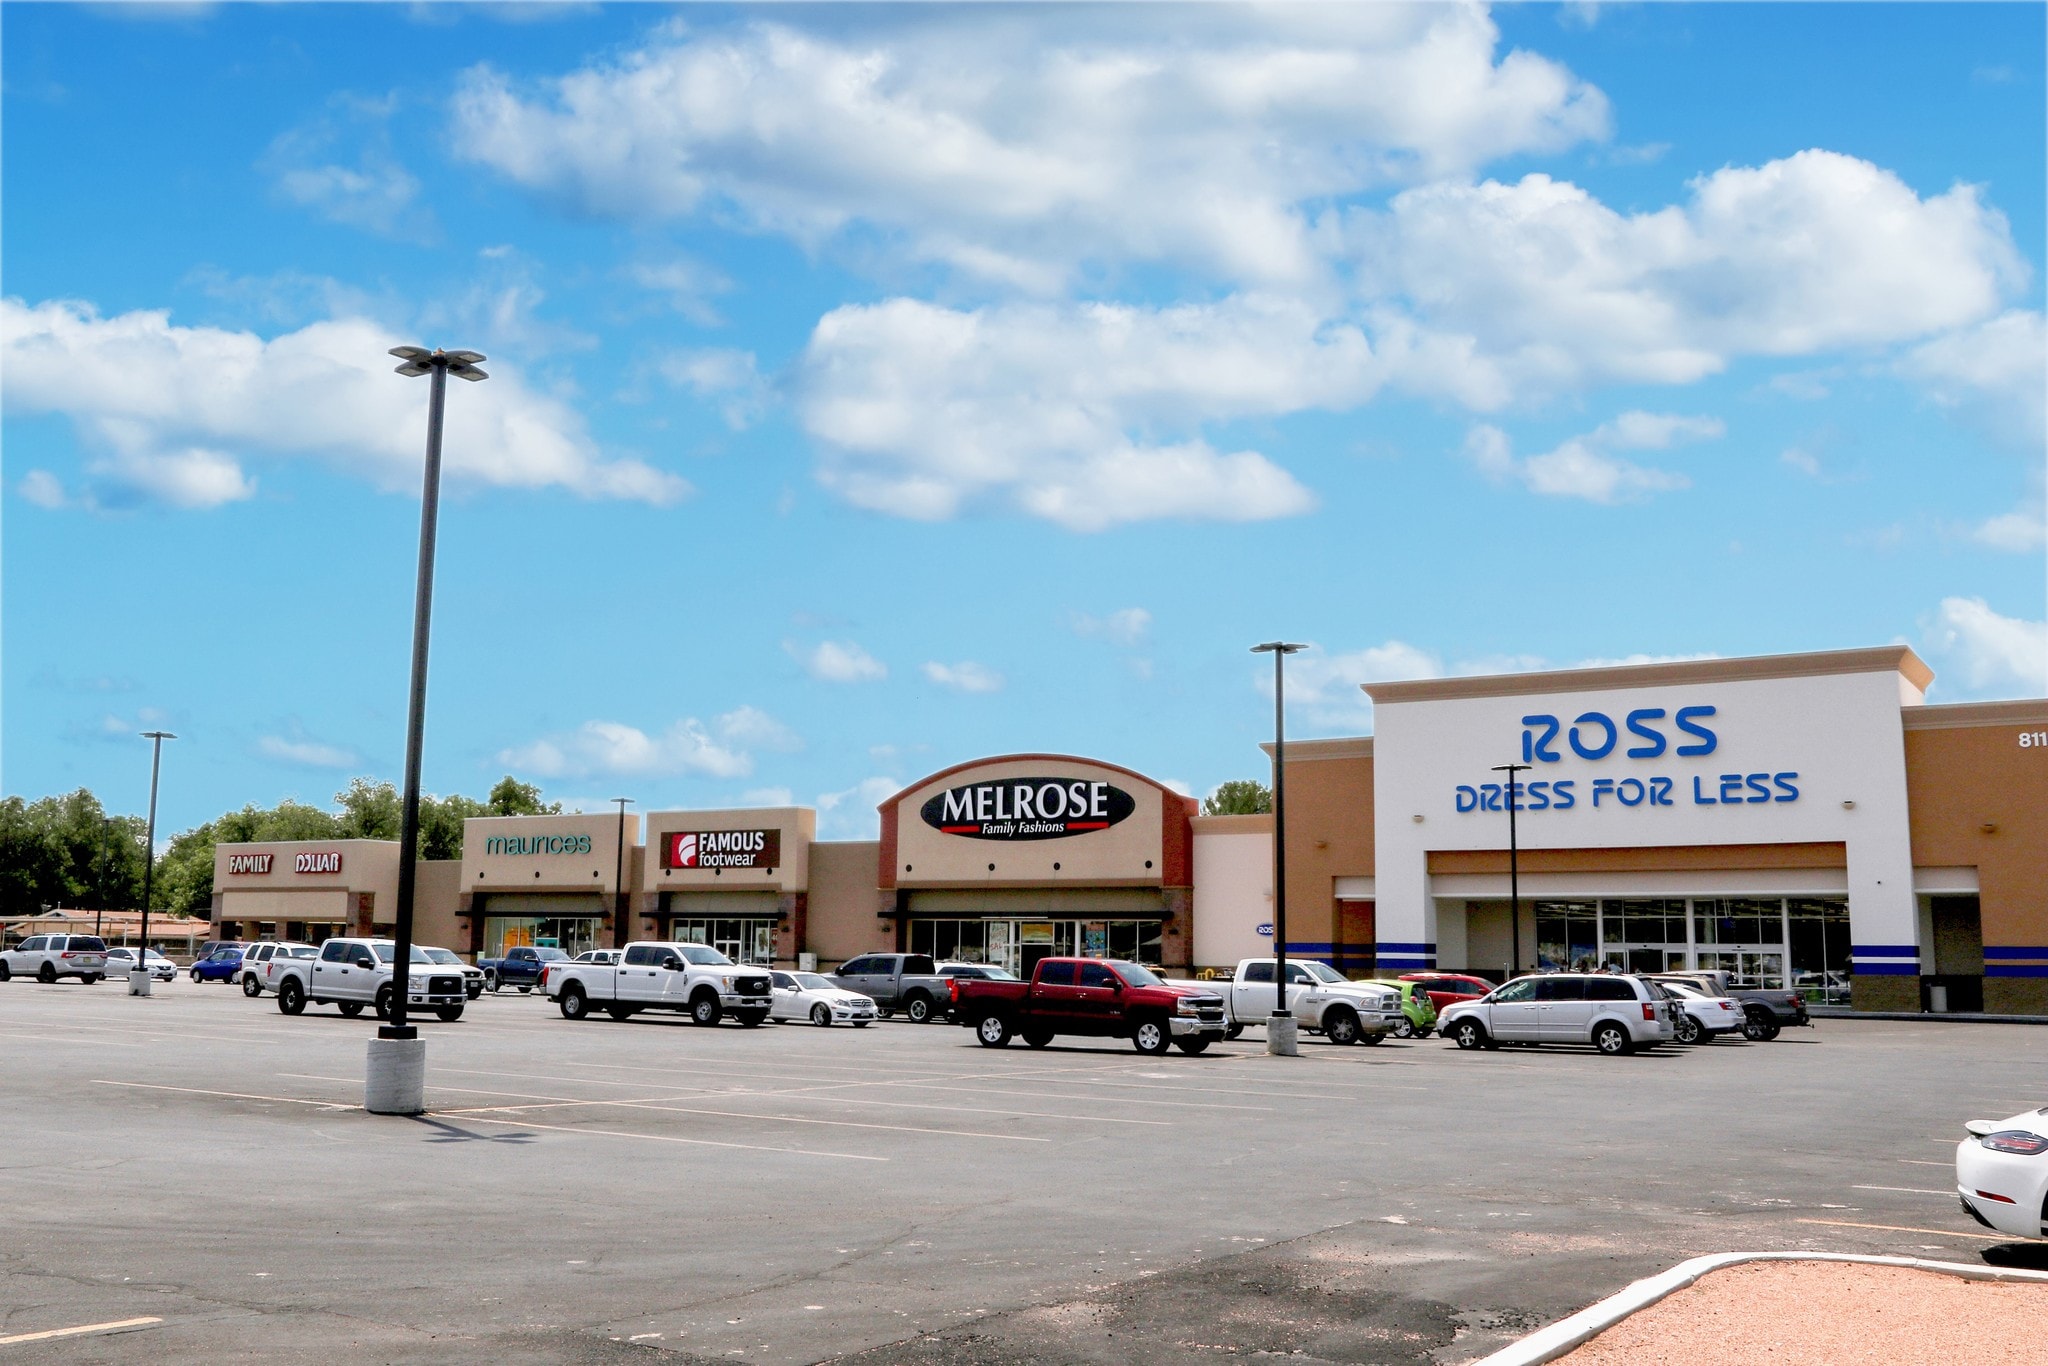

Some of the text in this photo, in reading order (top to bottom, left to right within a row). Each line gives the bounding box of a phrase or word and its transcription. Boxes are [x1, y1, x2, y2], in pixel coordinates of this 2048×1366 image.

[1521, 705, 1718, 763] ROSS
[942, 781, 1108, 822] MELROSE
[1455, 771, 1800, 813] DRESS FOR LESS
[982, 820, 1065, 837] Family Fashions
[486, 834, 591, 855] maurices
[699, 831, 764, 852] FAMOUS
[228, 852, 342, 873] FAMILY DOLLAR
[699, 851, 756, 868] footwear
[1258, 926, 1274, 934] ROS
